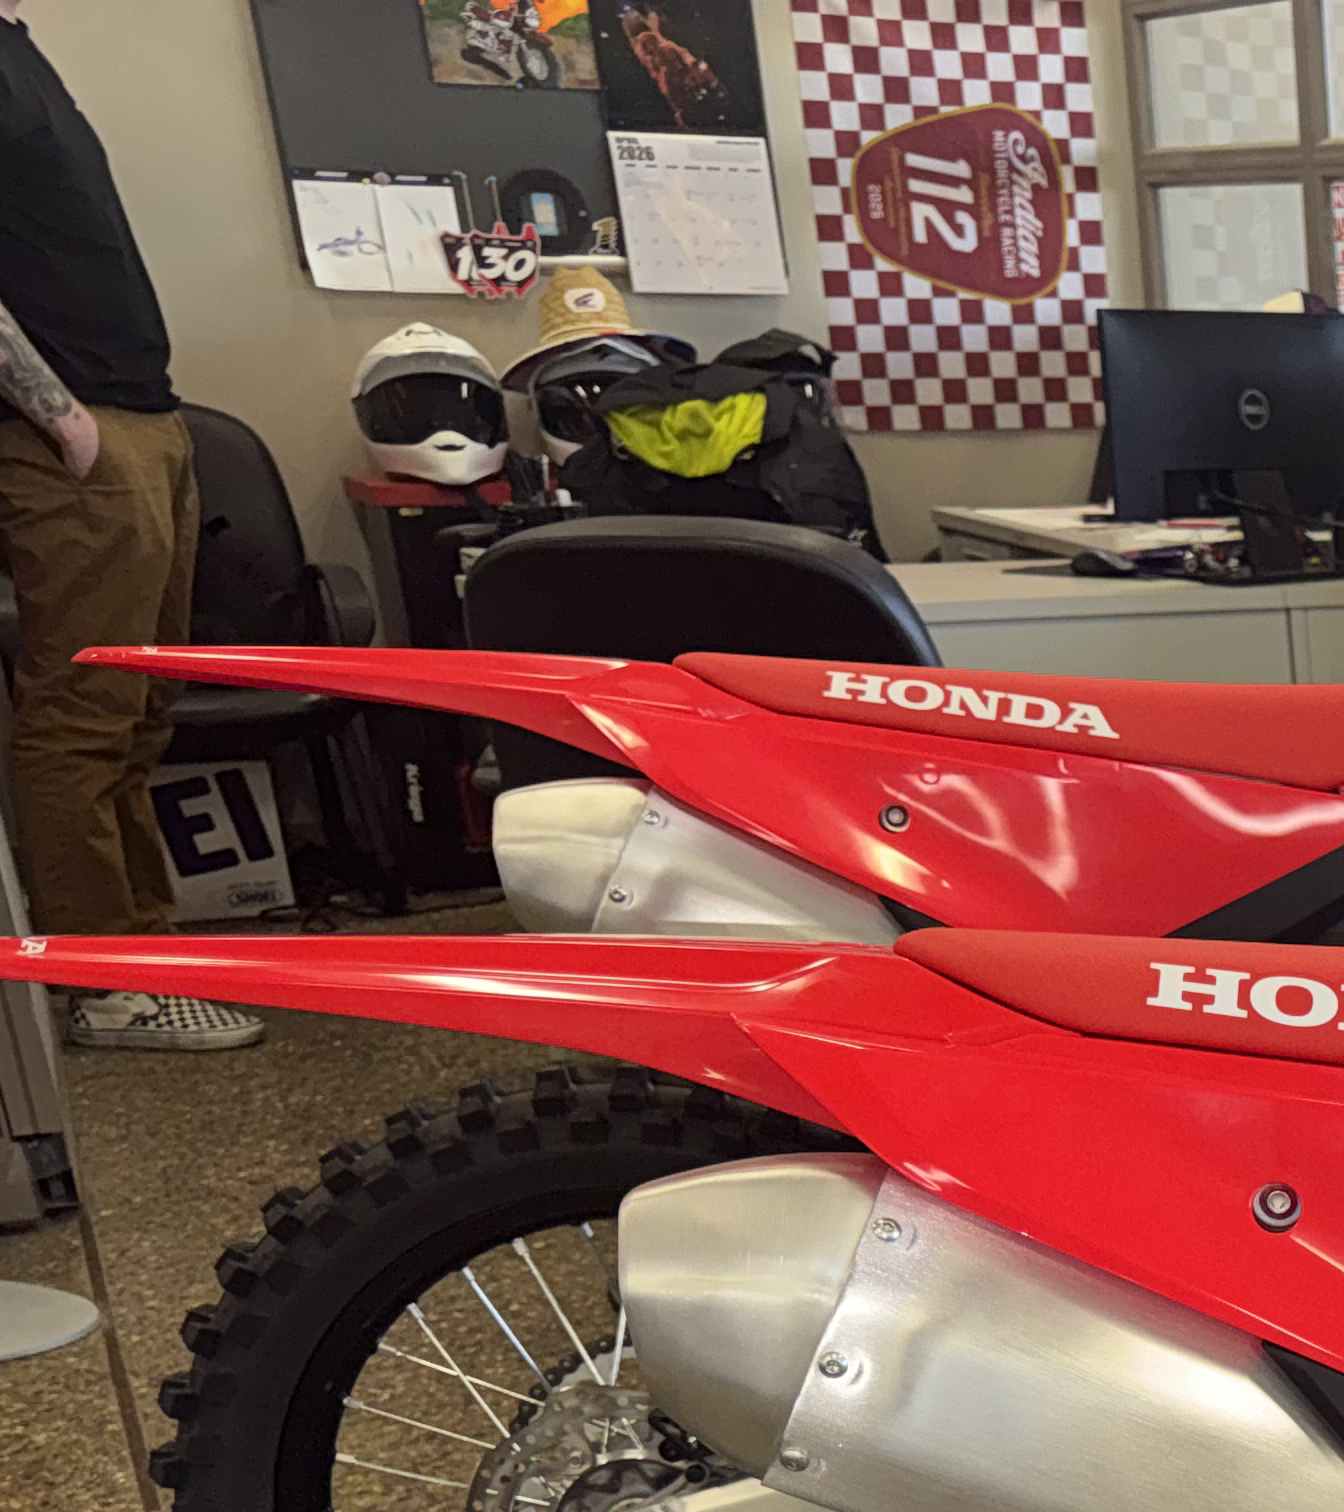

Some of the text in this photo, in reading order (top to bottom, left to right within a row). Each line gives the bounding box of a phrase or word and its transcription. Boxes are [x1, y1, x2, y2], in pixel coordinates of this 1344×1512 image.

[904, 151, 979, 254] 112
[992, 129, 1019, 279] MOTORCYCLE RACING
[1007, 129, 1050, 279] Indian
[822, 670, 1120, 740] HONDA
